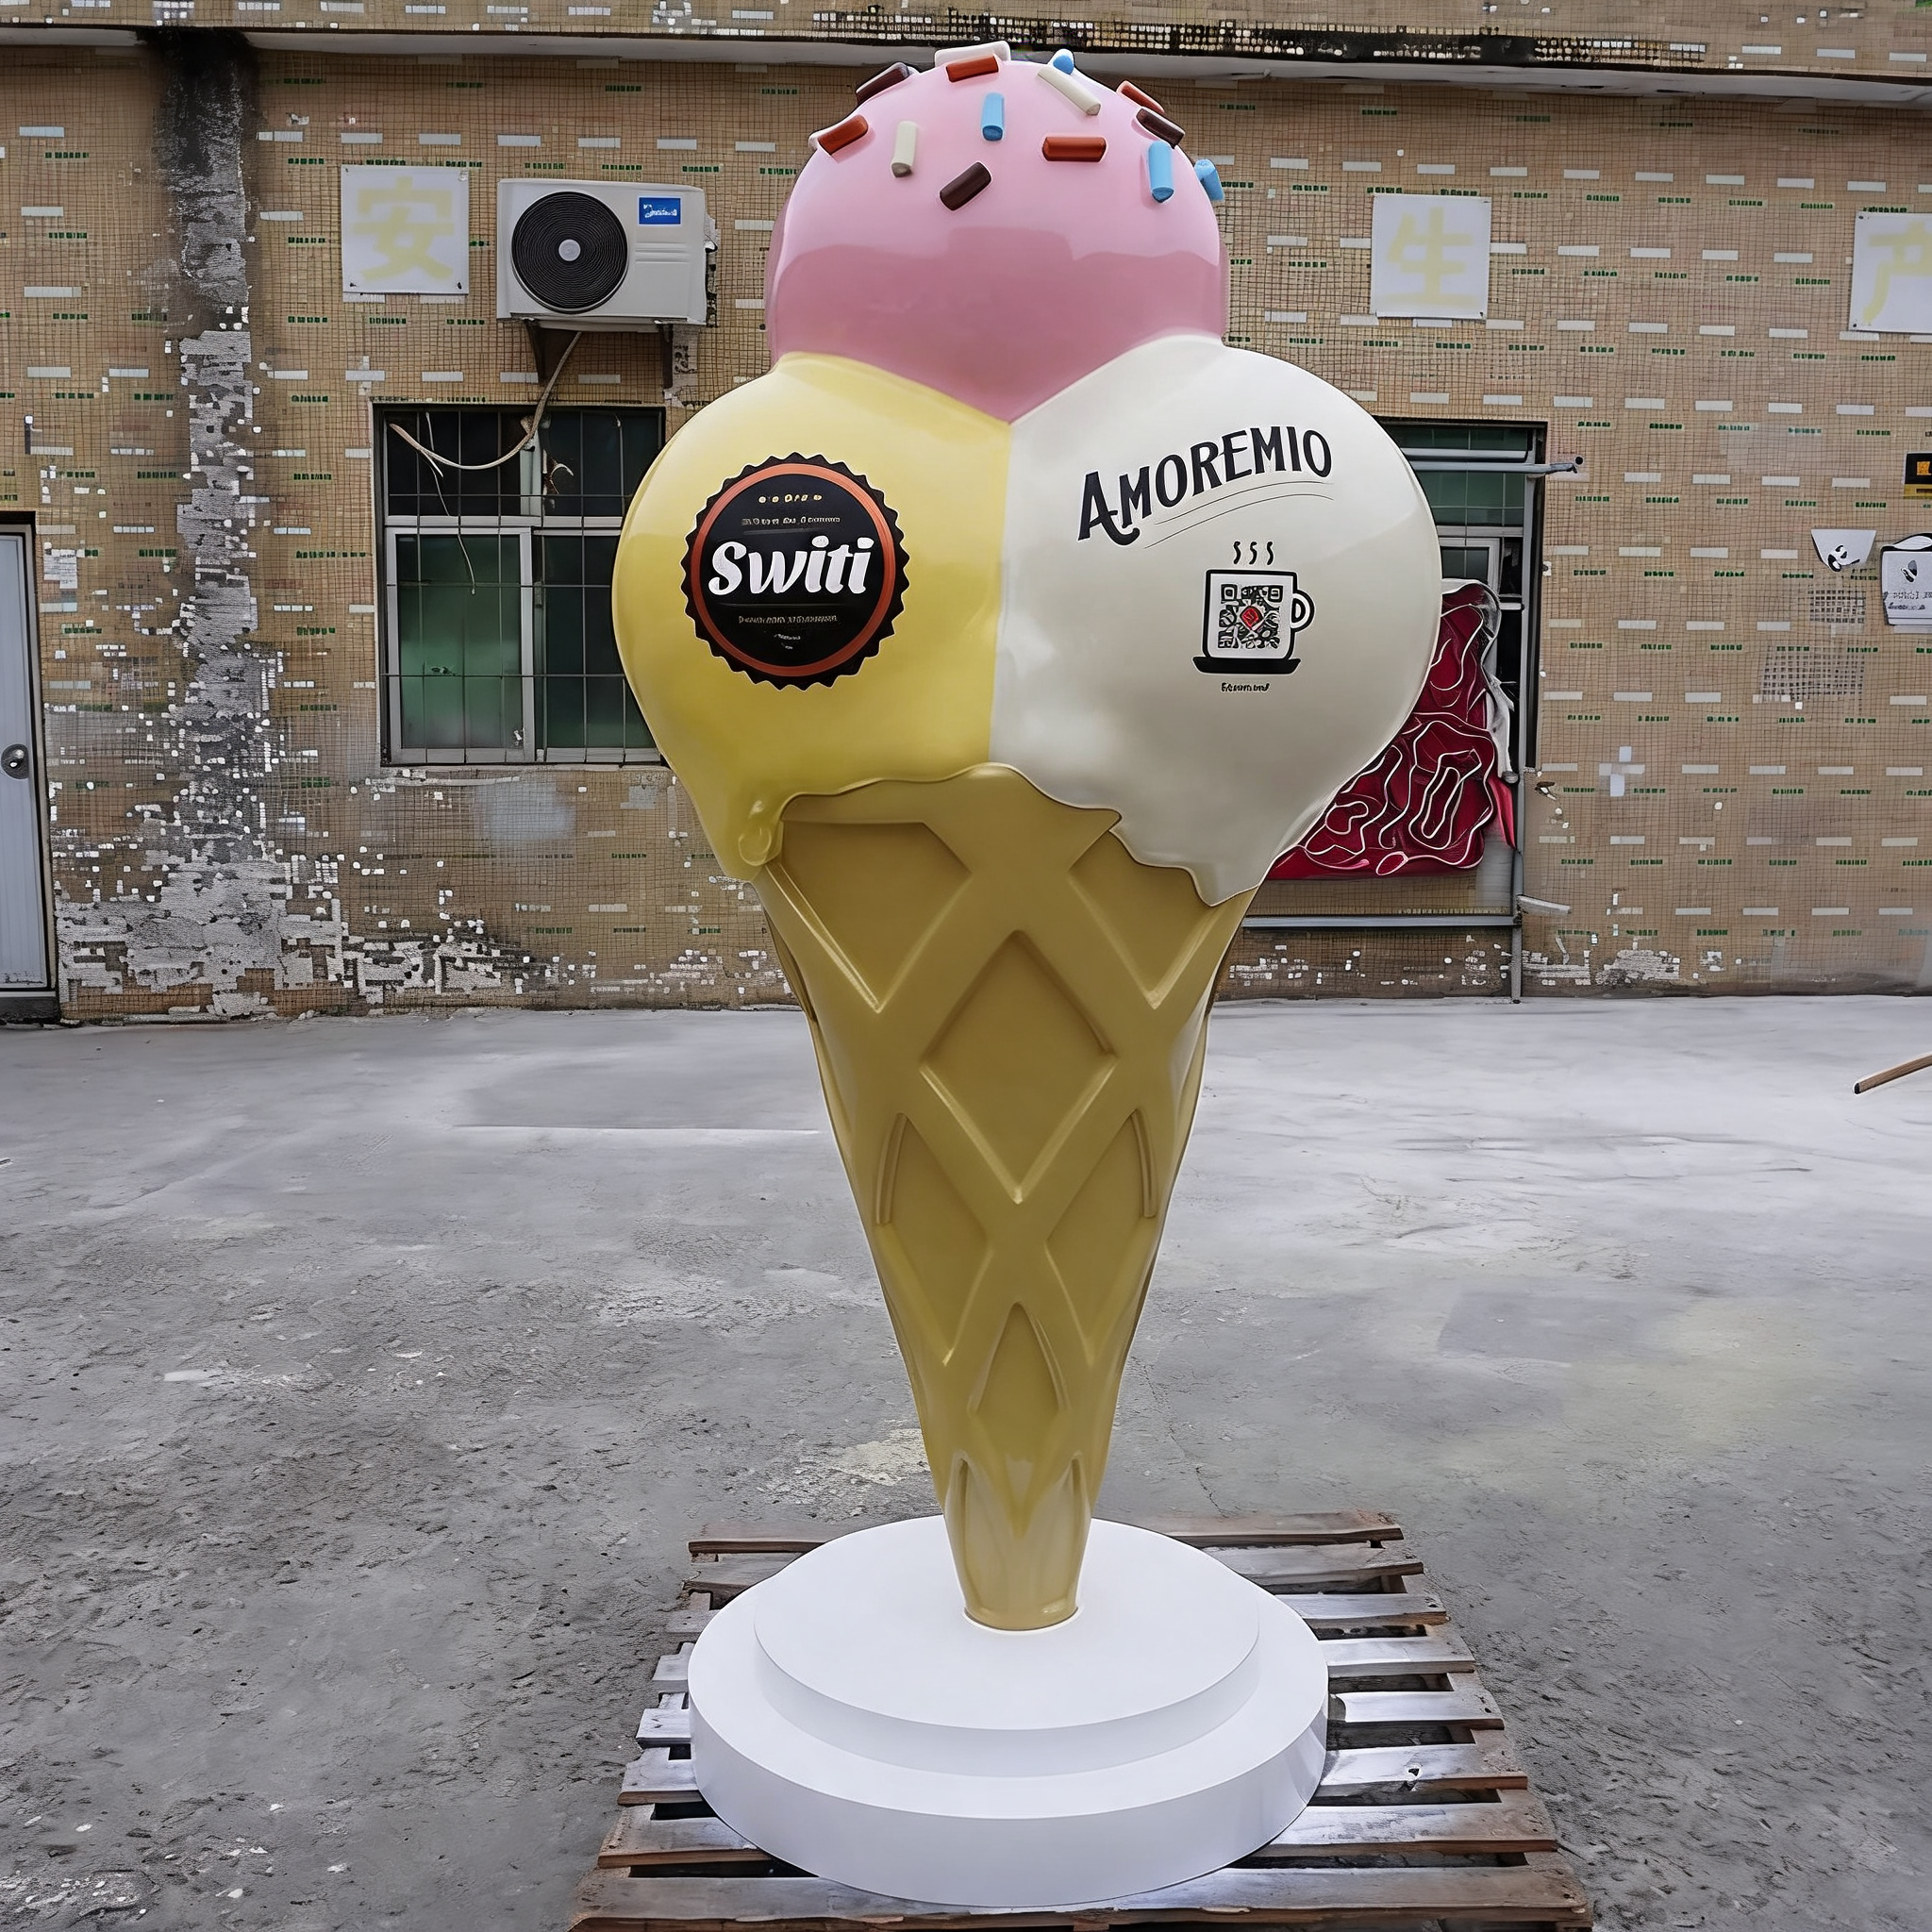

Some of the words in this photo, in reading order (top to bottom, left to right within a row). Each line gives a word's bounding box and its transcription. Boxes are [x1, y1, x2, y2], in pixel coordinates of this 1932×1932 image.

[352, 175, 455, 281] 安
[1379, 207, 1481, 308] 生
[1077, 425, 1333, 547] AMOREMIO
[708, 535, 874, 596] Switi
